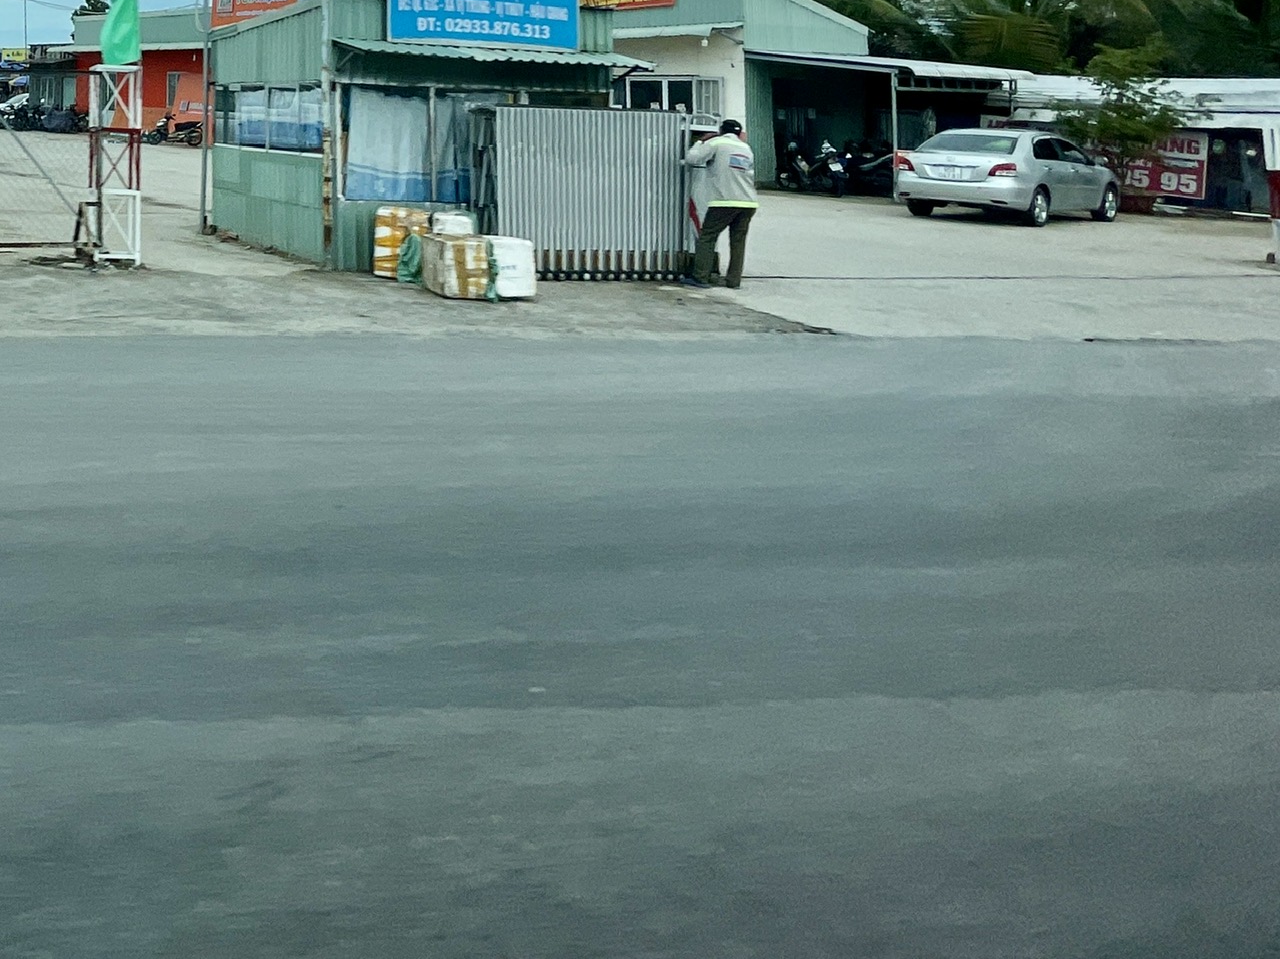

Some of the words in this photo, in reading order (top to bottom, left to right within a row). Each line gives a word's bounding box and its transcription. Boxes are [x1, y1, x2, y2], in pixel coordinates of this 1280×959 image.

[417, 16, 441, 31] ĐT:
[444, 17, 550, 39] 02933.876.313
[1160, 171, 1197, 193] 95
